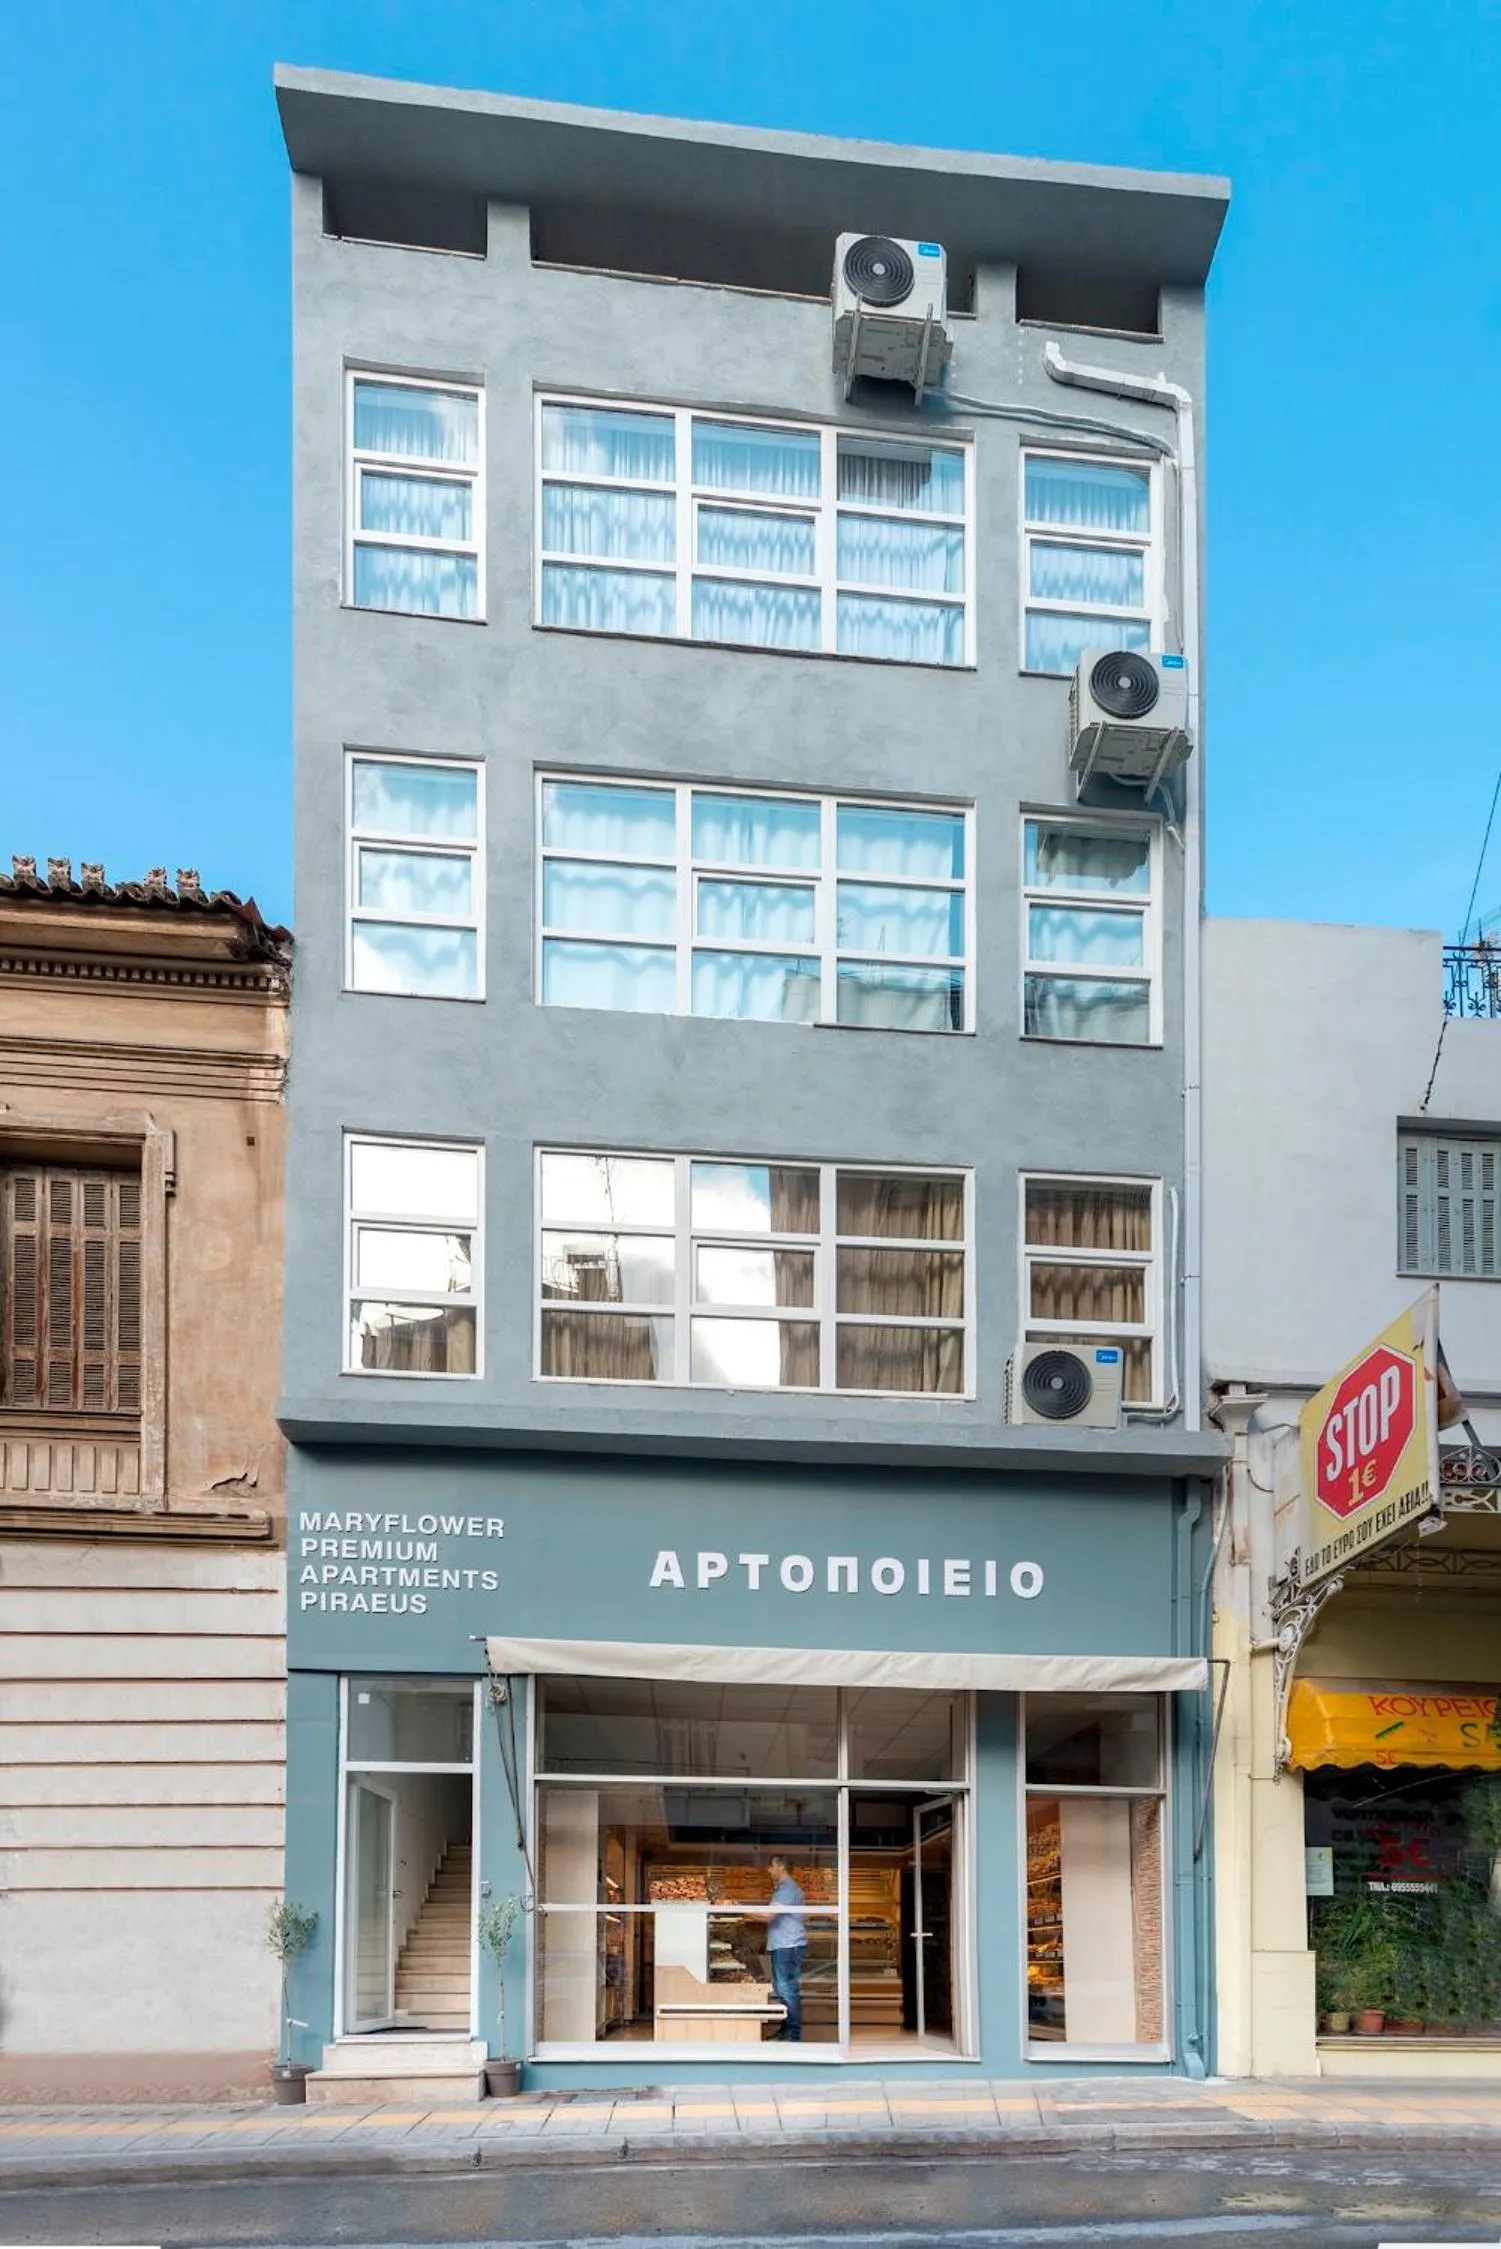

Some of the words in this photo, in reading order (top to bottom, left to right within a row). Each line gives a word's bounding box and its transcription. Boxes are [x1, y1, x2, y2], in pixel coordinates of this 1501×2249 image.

[1326, 1365, 1400, 1482] STOP
[1348, 1458, 1377, 1506] 1€
[299, 1512, 505, 1538] MARYFLOWER
[301, 1538, 438, 1562] PREMIUM
[299, 1564, 499, 1590] APARTMENTS
[648, 1550, 1045, 1600] ΑΡΤΟΠΟΙΕΙΟ
[300, 1591, 428, 1614] PIRAEUS
